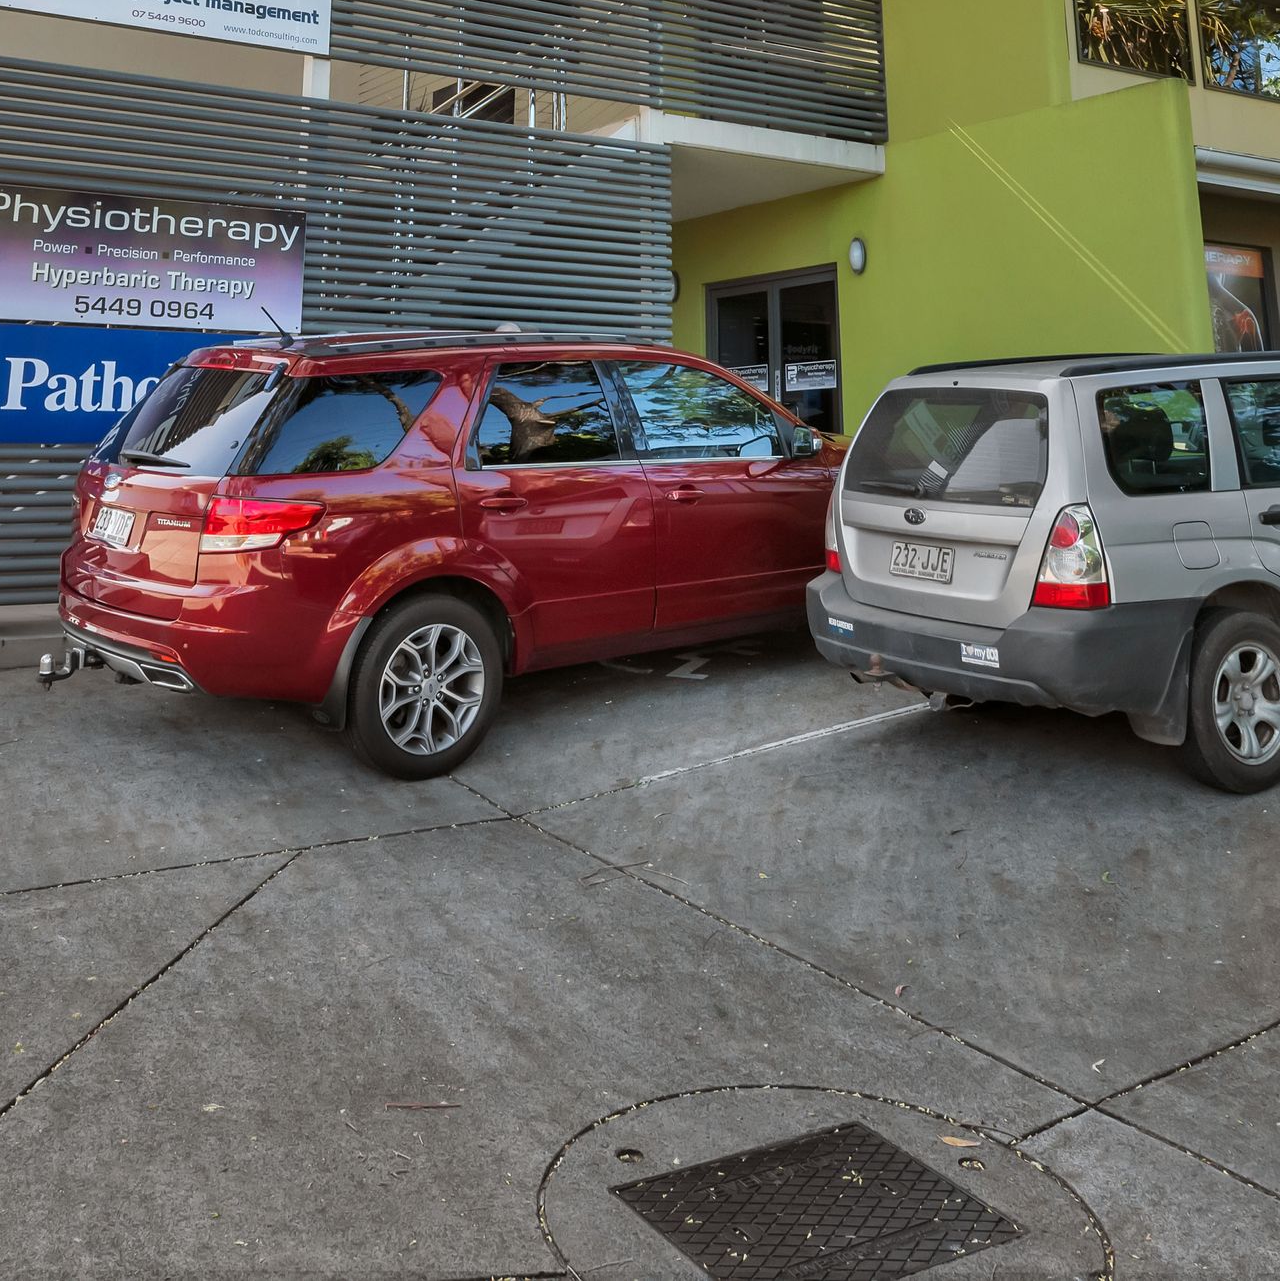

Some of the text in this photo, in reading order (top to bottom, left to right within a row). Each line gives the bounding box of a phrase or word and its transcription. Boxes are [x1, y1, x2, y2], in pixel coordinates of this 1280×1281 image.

[131, 9, 206, 28] 07 5449 9600
[223, 24, 318, 45] www.todconsulting.com
[32, 239, 256, 267] Power Precision Performance
[31, 262, 255, 299] Hyperbaric Therapy
[74, 295, 215, 320] 5449 0964
[156, 518, 191, 528] TITANIUM
